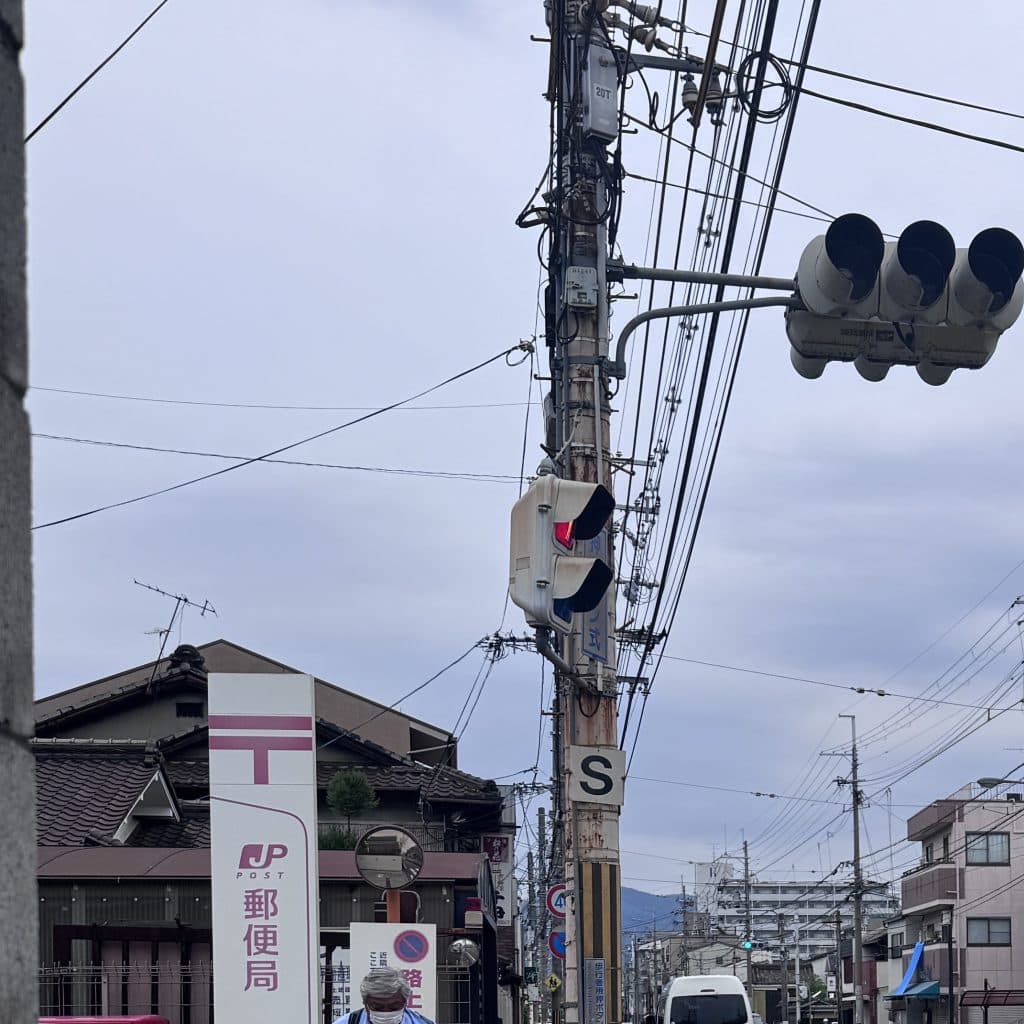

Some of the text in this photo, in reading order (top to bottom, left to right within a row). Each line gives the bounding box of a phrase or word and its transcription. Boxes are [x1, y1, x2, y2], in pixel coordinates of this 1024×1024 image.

[595, 86, 612, 99] 20T
[580, 755, 613, 795] S
[238, 844, 289, 869] JP
[236, 871, 285, 879] POST
[243, 888, 279, 992] 郵便局
